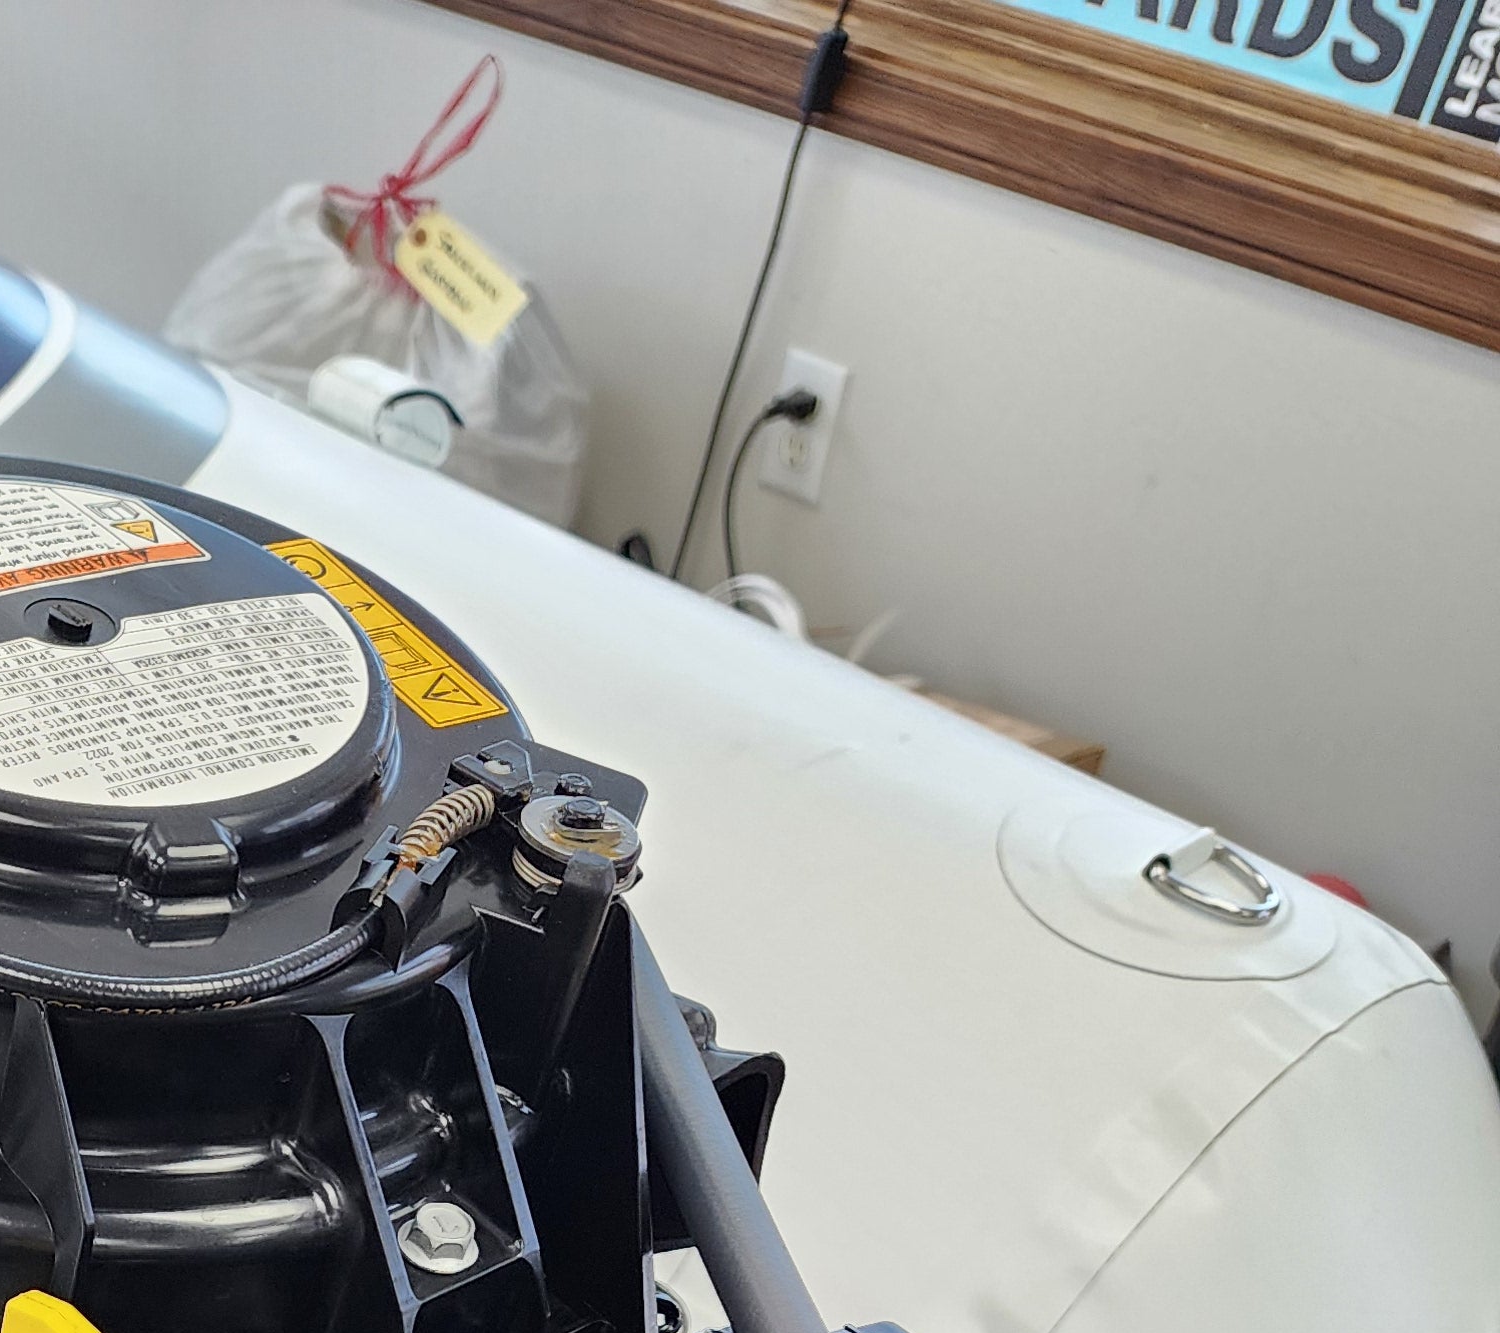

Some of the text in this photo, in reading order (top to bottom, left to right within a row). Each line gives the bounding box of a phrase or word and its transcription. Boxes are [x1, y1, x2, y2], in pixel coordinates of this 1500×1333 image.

[29, 535, 72, 548] hands,
[20, 549, 61, 563] injury,
[61, 544, 95, 556] avoid
[27, 554, 128, 579] WARNING
[276, 607, 313, 619] SPARK
[169, 634, 207, 646] liters
[251, 634, 293, 647] FAMILY
[294, 628, 338, 641] ENGINE
[0, 642, 33, 654] VALVE
[11, 650, 55, 665] SPARK
[38, 654, 102, 673] EMISSION
[50, 666, 114, 685] MAXIMUM
[220, 665, 269, 679] NORMAL
[259, 670, 309, 684] TUNE-UP
[311, 663, 353, 676] ENGINE
[151, 673, 217, 692] OPERATING
[277, 679, 327, 694] OWNER'S
[329, 673, 360, 686] YOUR
[0, 679, 49, 696] ENGINE
[160, 678, 258, 703] SPECIFICATIONS
[226, 687, 276, 702] MANUAL
[320, 687, 349, 699] THIS
[62, 686, 150, 711] TEMPERATURE
[132, 696, 159, 709] AND
[203, 696, 227, 707] FOR
[253, 692, 320, 710] EQUIPMENT
[28, 704, 62, 720] WITH
[130, 700, 201, 722] ADDITIONAL
[182, 711, 210, 724] U.S.
[212, 703, 252, 718] MEETS
[40, 715, 129, 742] MAINTENANCE
[77, 699, 354, 761] CALIFORNIA EXHAUST REGULATIONS FOR 2022.
[124, 722, 155, 736] EVAP
[156, 717, 182, 729] EPA
[32, 713, 342, 787] THIS MARINE ENGINE COMPLIES WITH U.S. EPA AND
[41, 731, 118, 756] STANDARDS.
[1, 750, 40, 767] REFER
[102, 735, 286, 783] SUZUKI MOTOR CORPORATION
[107, 745, 317, 798] EMISSION CONTROL INFORMATION
